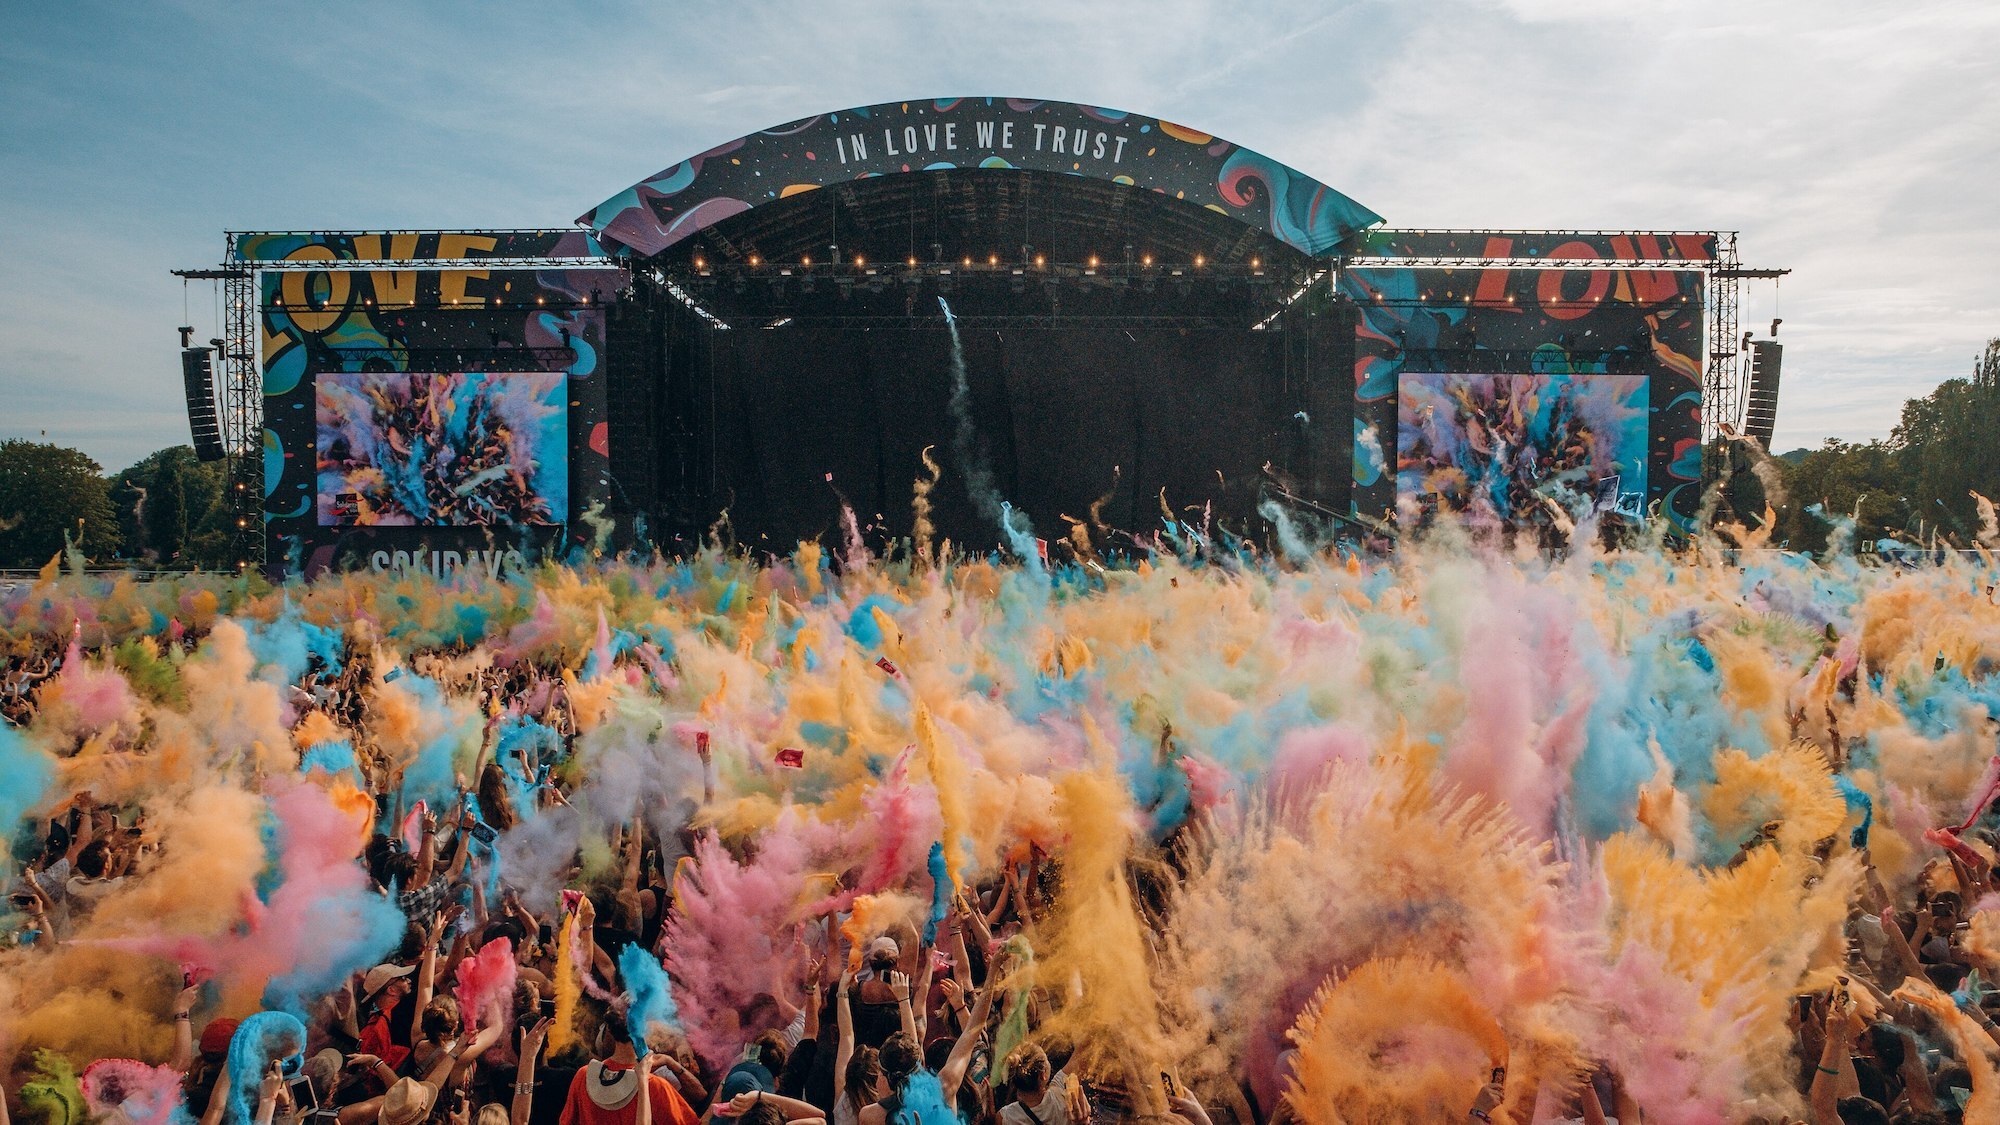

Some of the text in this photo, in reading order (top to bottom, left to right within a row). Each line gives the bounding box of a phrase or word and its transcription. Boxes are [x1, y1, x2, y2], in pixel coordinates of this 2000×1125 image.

[836, 121, 1129, 165] IN LOVE WE TRUST
